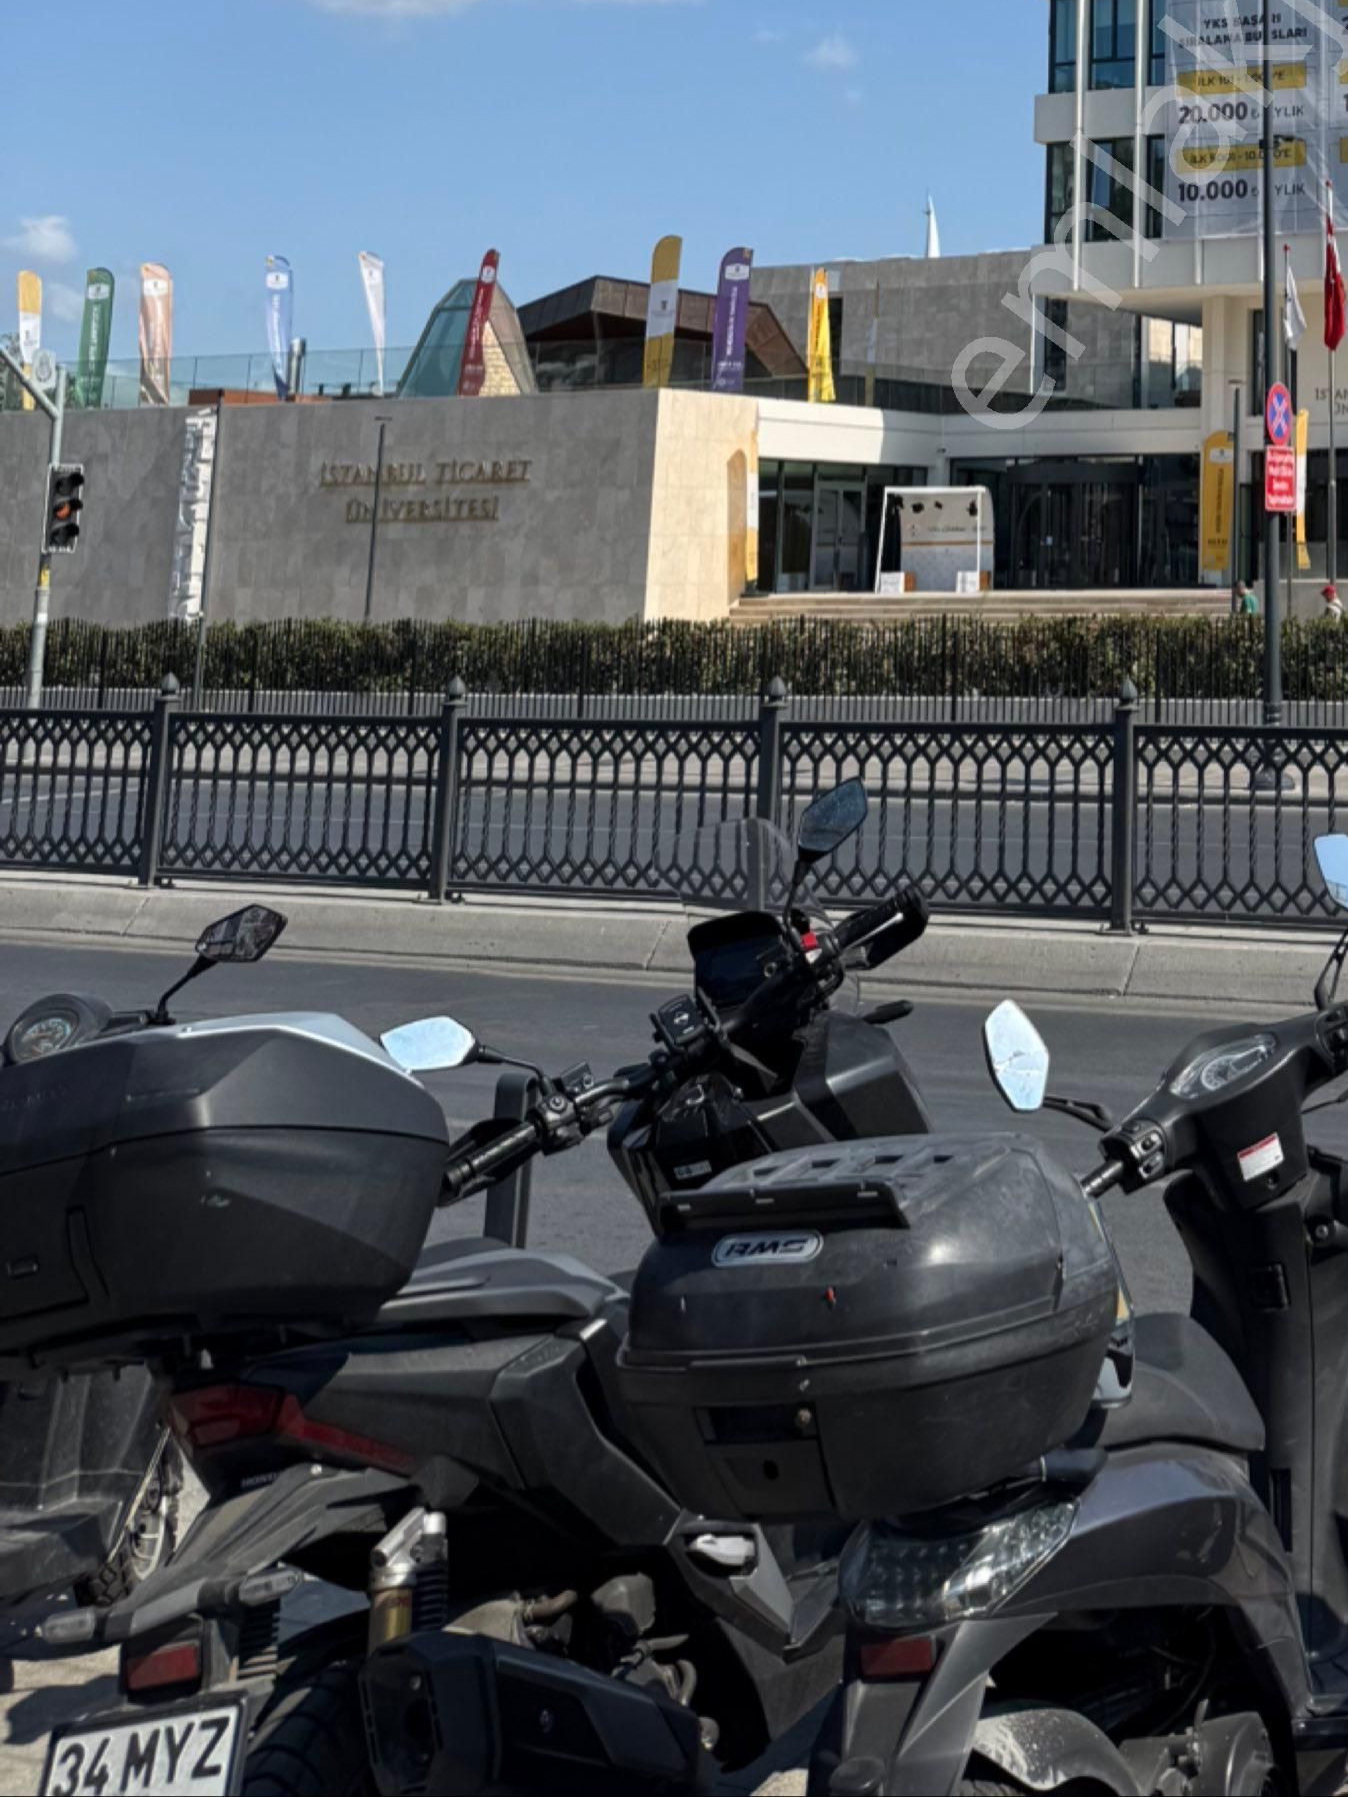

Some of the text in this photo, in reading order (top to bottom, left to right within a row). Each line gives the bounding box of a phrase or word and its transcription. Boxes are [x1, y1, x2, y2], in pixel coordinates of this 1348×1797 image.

[1245, 26, 1308, 43] BUSLARI
[1178, 101, 1249, 125] 20.000
[1178, 178, 1249, 202] 10.000
[320, 457, 532, 488] İSTANBUL TİCARET
[345, 496, 499, 524] ÜNİVERSİTESİ
[725, 1238, 810, 1258] RMS
[52, 1716, 231, 1797] 34 MYZ
